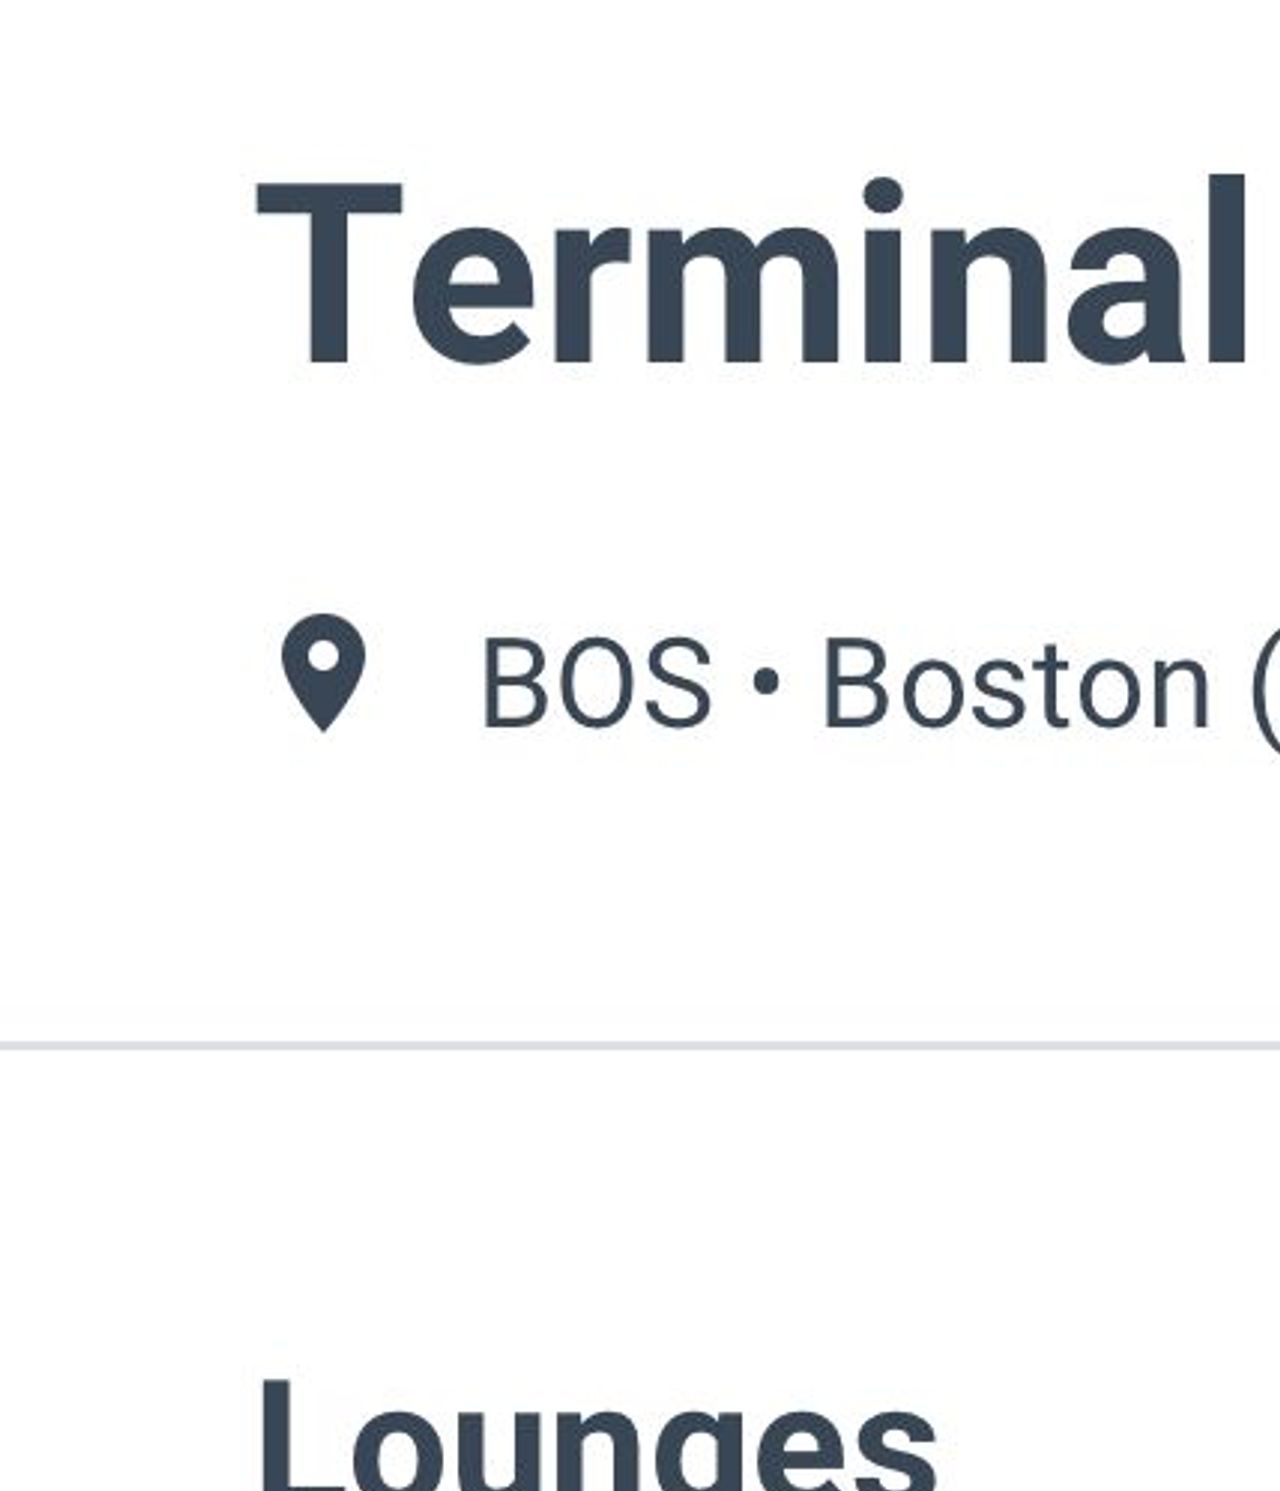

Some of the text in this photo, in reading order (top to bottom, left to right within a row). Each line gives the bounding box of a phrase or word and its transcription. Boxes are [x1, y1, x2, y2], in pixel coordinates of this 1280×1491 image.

[255, 173, 1245, 366] Terminal
[485, 636, 711, 730] BOS
[826, 637, 1208, 730] Boston
